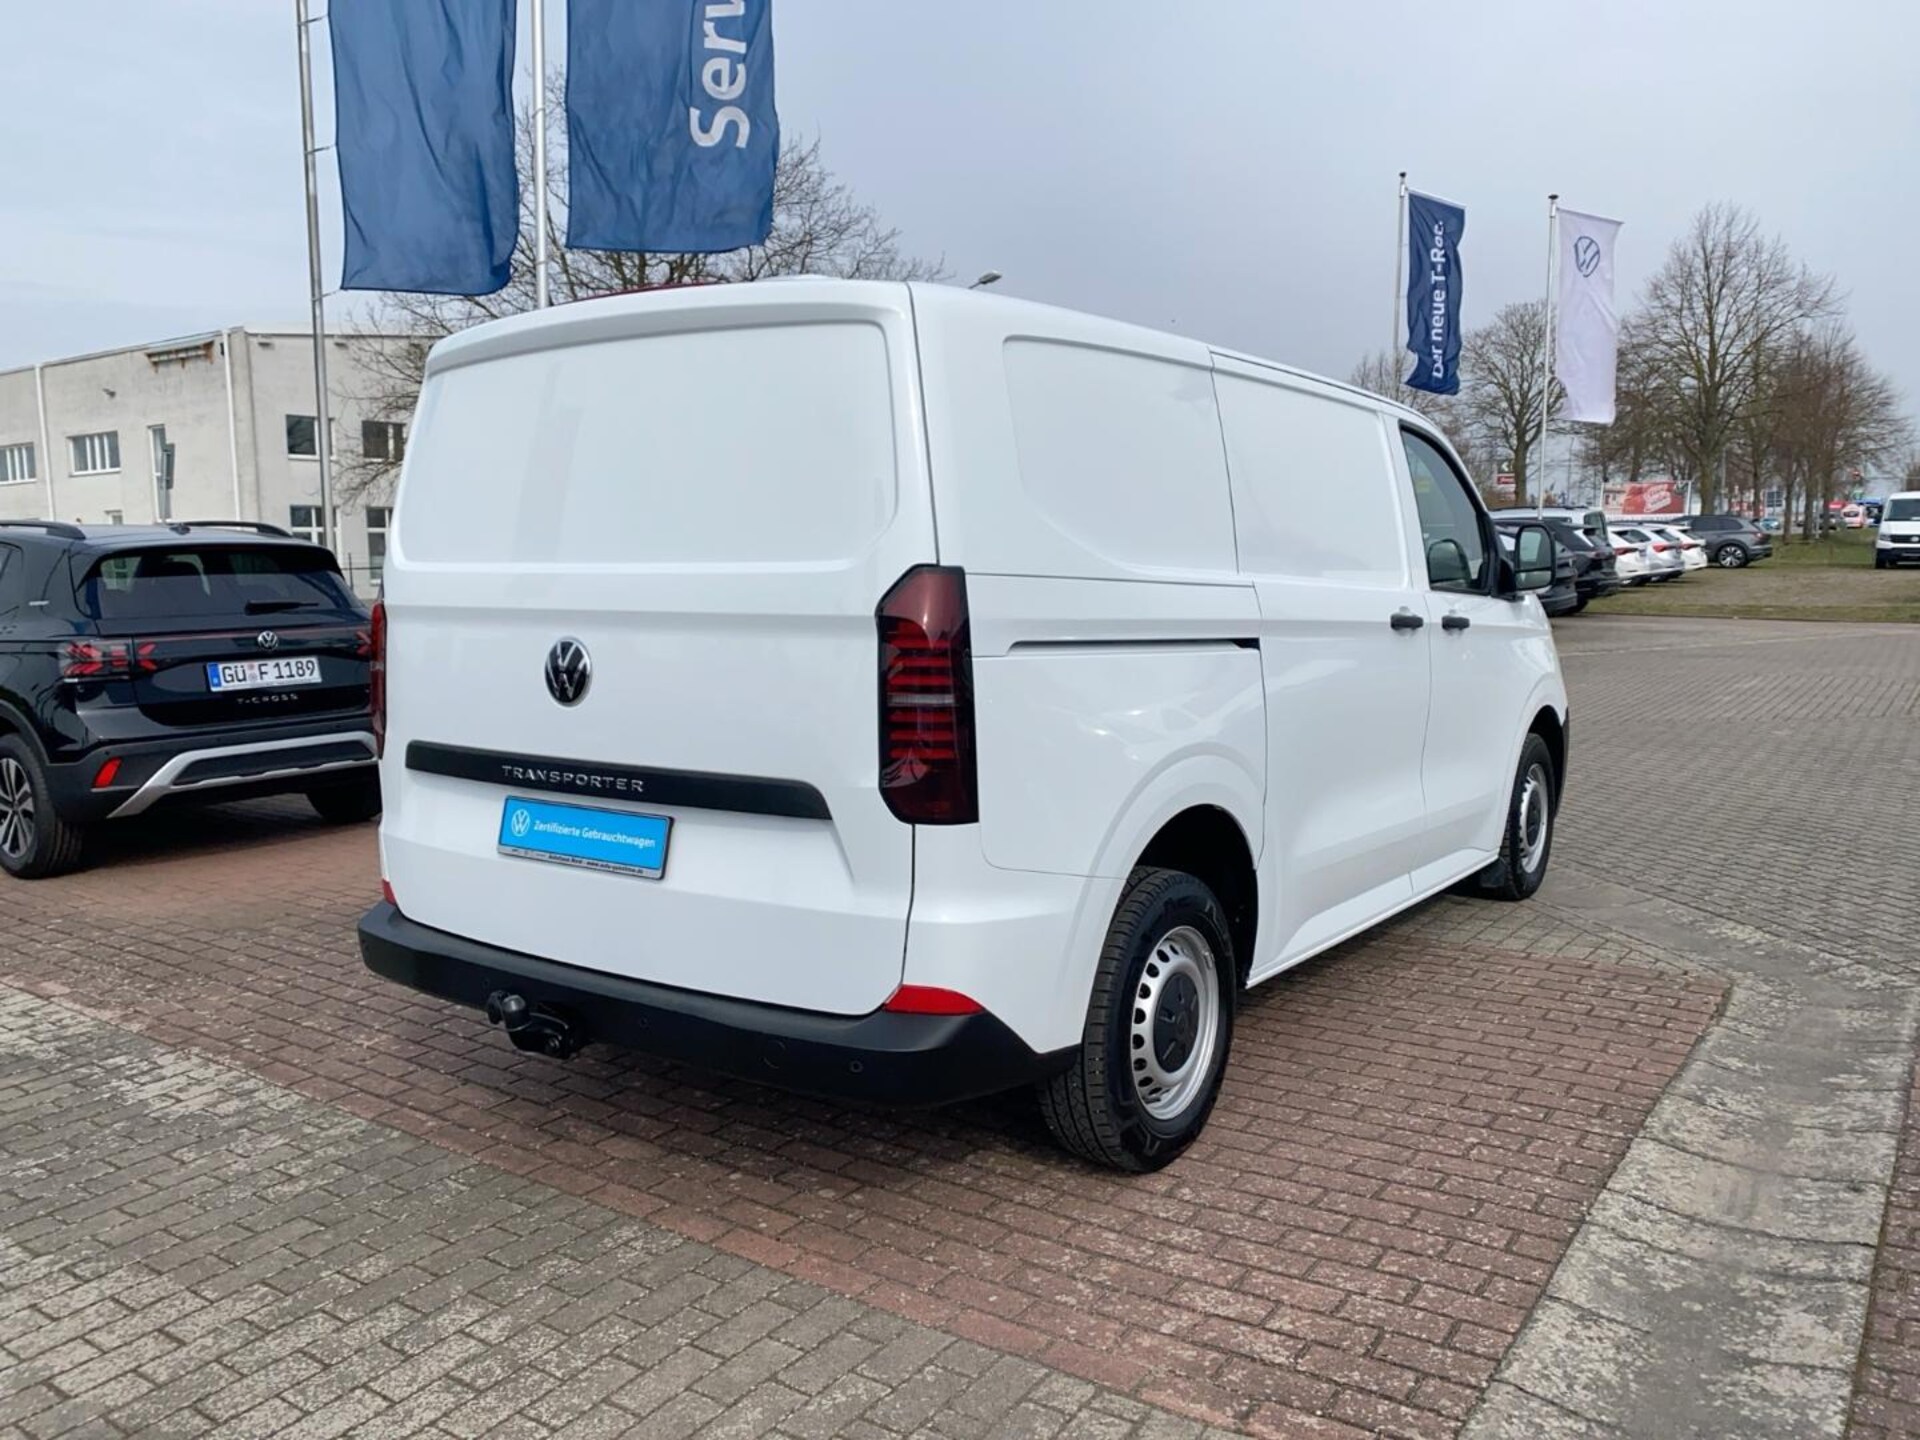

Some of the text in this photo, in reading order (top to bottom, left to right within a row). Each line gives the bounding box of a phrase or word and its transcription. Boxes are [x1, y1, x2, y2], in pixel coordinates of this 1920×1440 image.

[1431, 289, 1445, 341] neue
[1431, 345, 1444, 379] Der
[222, 660, 316, 683] GÜ F 1189
[501, 765, 645, 792] TRANSPORTER
[534, 820, 656, 850] Zertifizierte Gebrauchtwagen
